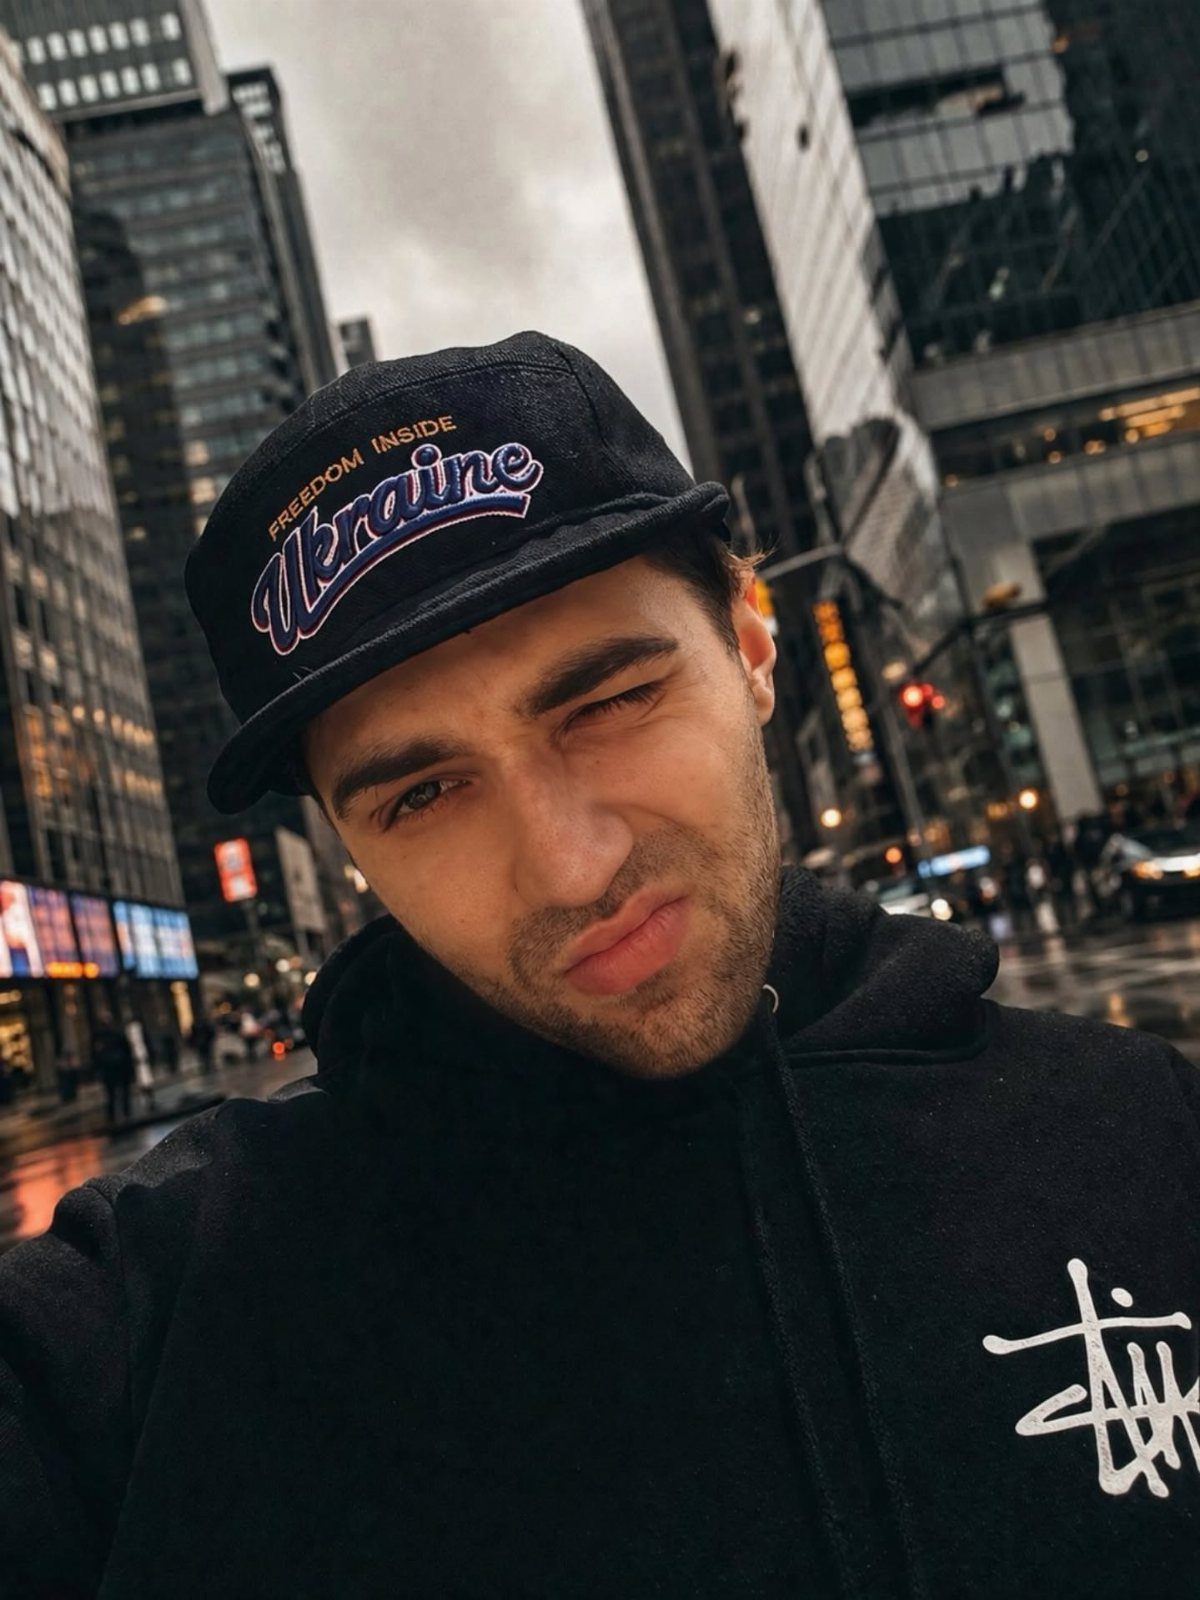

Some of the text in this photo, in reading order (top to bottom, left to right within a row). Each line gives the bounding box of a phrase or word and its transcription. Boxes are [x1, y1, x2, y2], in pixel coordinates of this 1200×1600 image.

[251, 442, 544, 655] Ukraine
[268, 415, 457, 541] FREEDOM INSIDE
